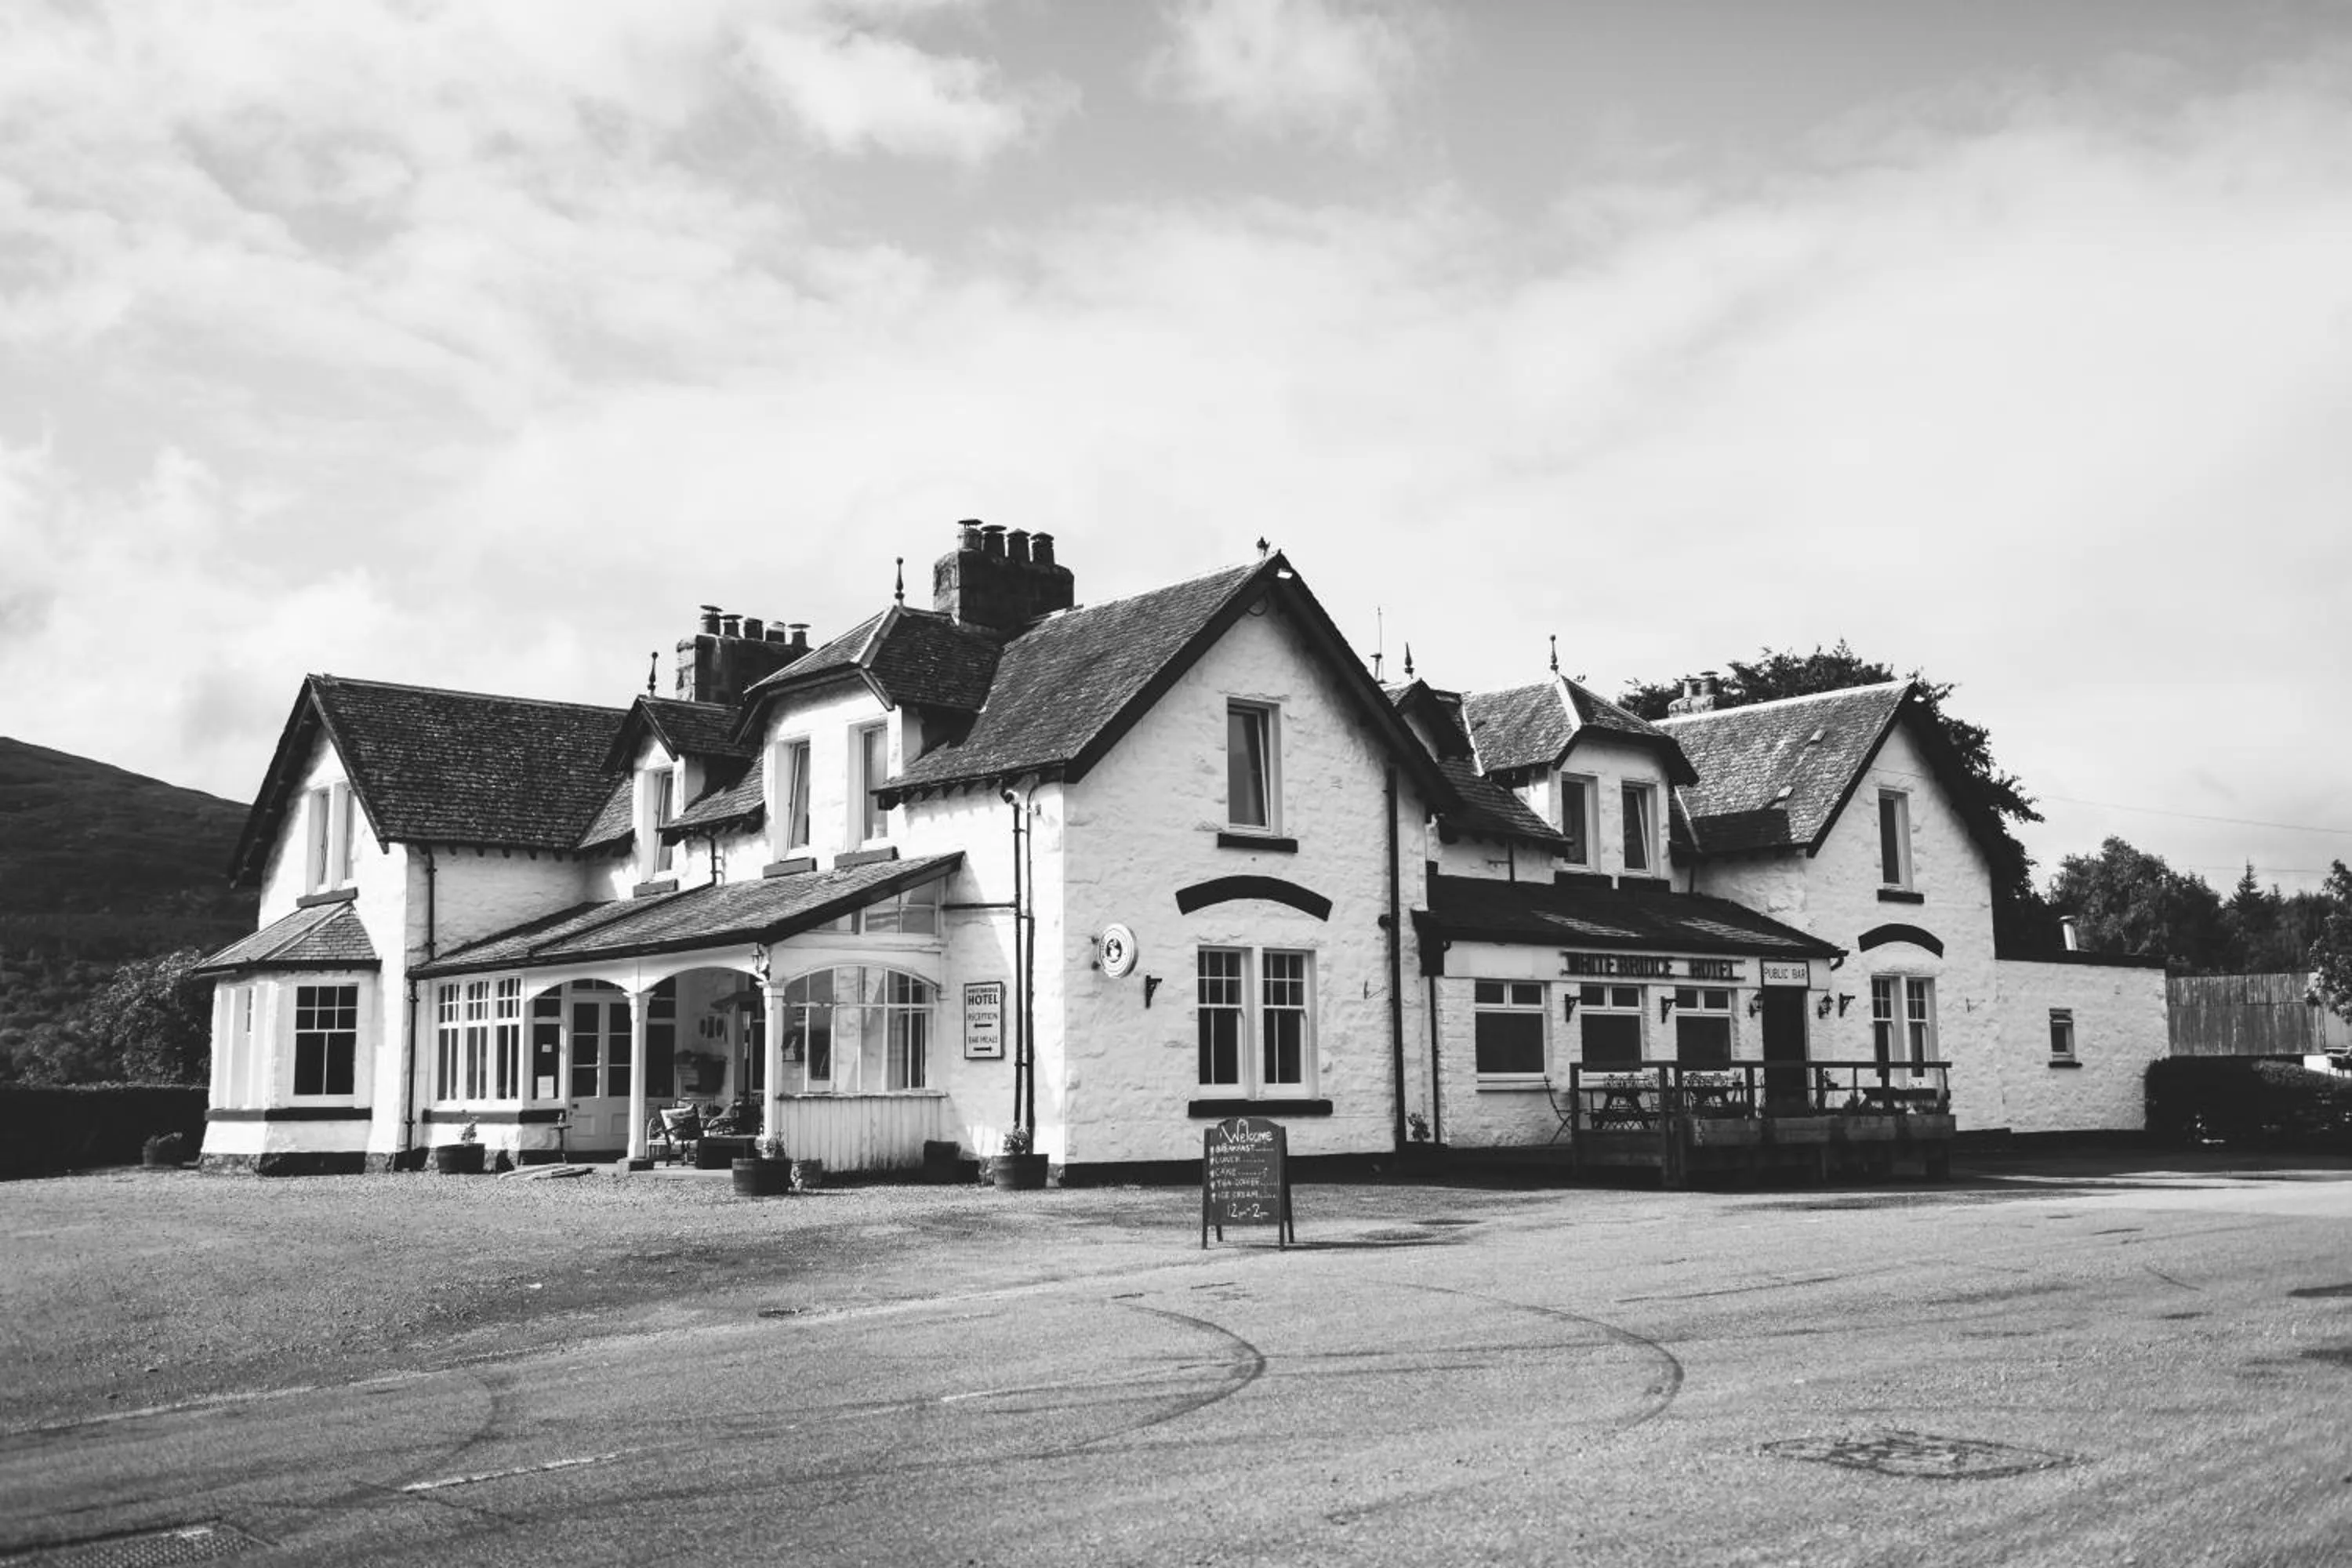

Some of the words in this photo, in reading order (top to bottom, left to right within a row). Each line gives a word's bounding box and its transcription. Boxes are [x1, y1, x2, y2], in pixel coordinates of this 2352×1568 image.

[1763, 967, 1788, 979] PUBLIC
[1791, 967, 1806, 979] BAR
[967, 993, 998, 1005] HOTEL
[967, 1012, 998, 1021] RECEPTION
[1220, 1118, 1274, 1144] Welcome
